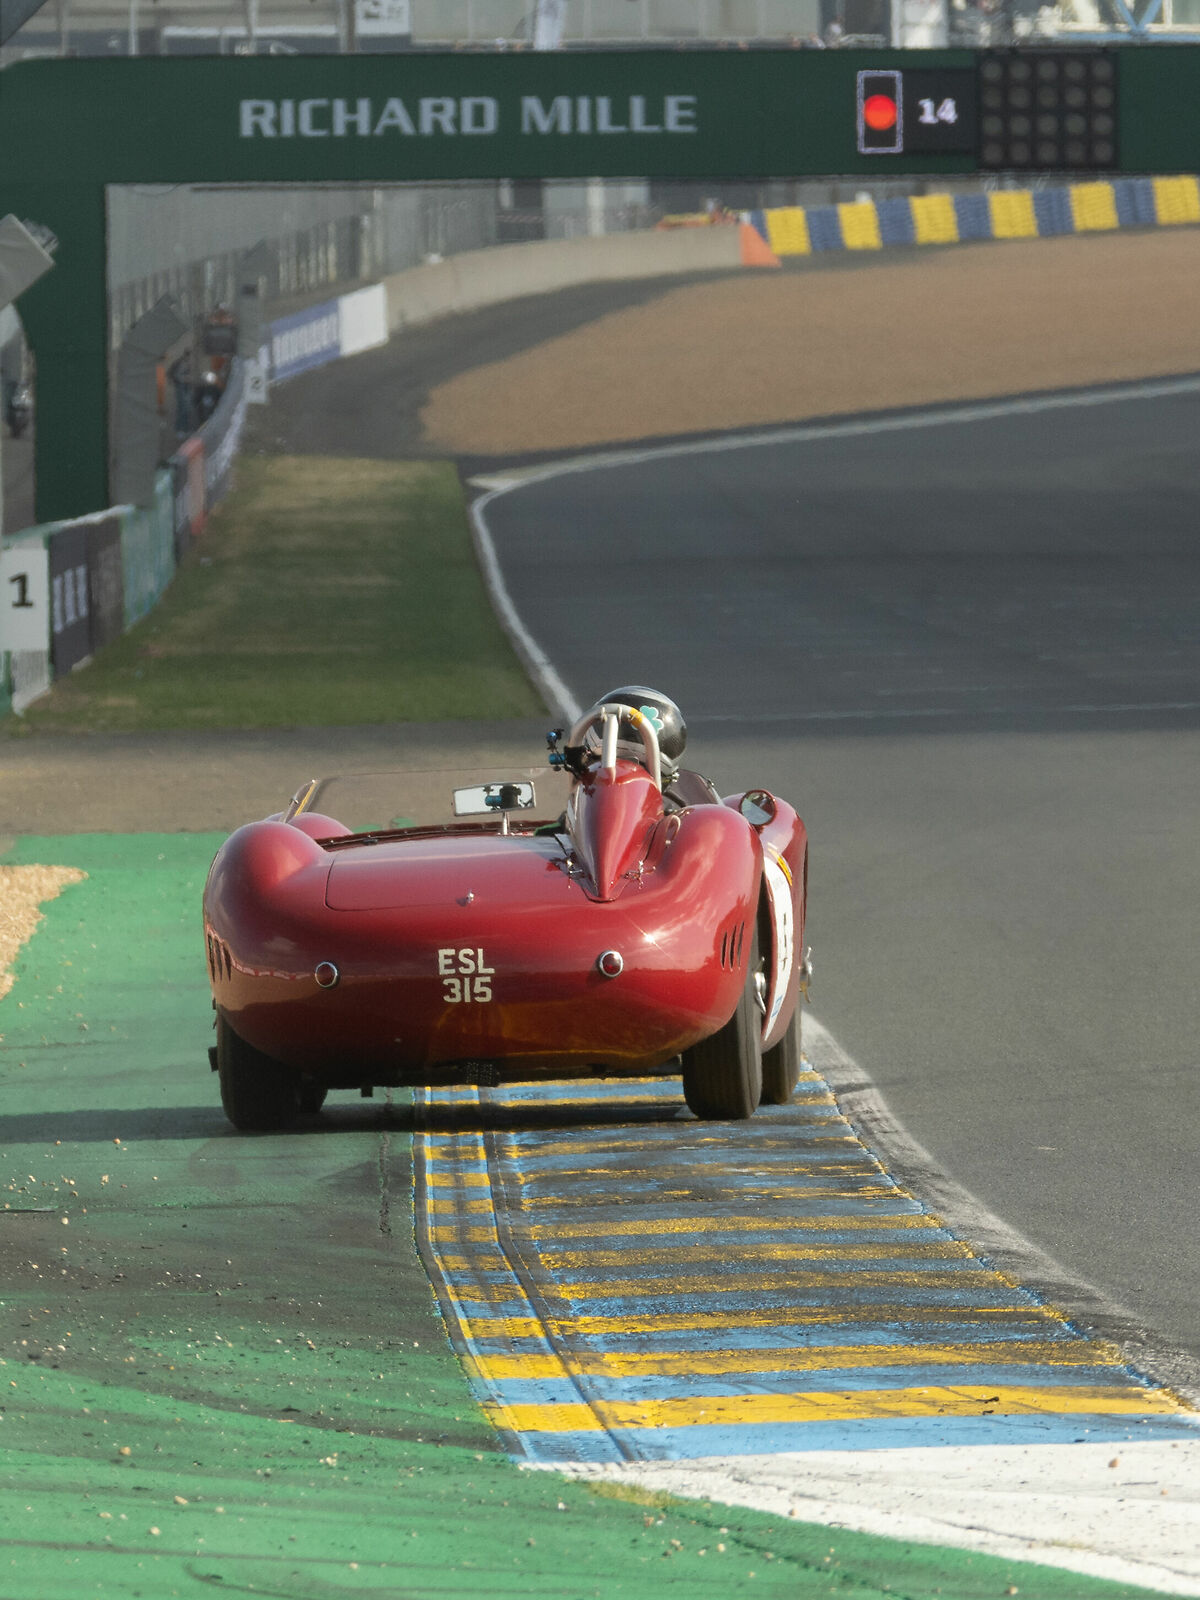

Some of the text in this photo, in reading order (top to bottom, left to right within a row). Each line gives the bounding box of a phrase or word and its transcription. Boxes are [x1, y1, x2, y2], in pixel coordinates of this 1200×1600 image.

[240, 95, 698, 138] RICHARD MILLE
[918, 98, 958, 125] 14
[9, 572, 34, 609] 1
[438, 948, 495, 976] ESL
[442, 976, 492, 1003] 315
